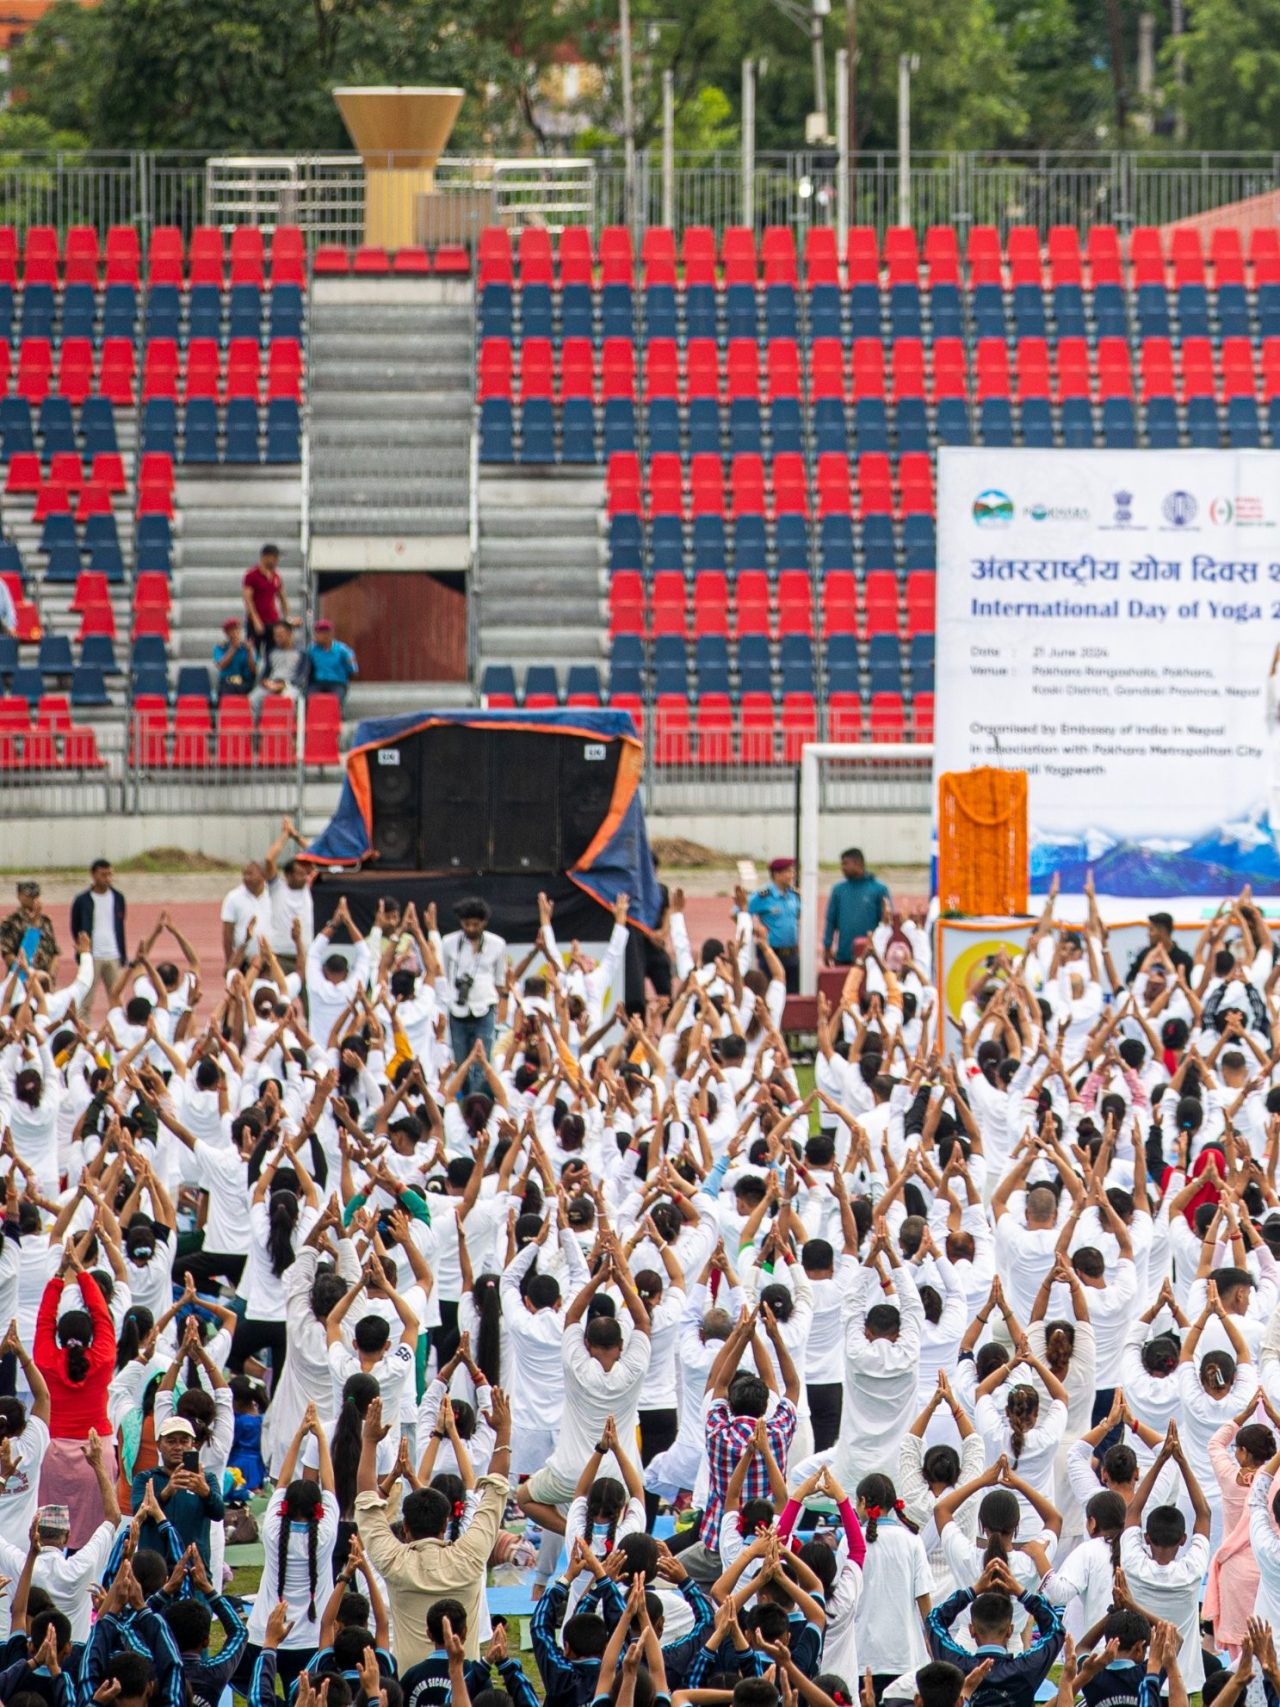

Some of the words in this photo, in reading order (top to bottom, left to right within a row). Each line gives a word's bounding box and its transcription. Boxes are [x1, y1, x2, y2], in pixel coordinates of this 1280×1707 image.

[971, 554, 1120, 587] अंतरराष्ट्रीय
[1129, 554, 1182, 582] योग
[1191, 554, 1259, 583] दिवस
[971, 598, 1119, 620] International
[1128, 598, 1169, 623] Day
[1178, 599, 1200, 620] of
[1208, 600, 1262, 624] Yoga
[970, 646, 1000, 657] Date
[1049, 647, 1077, 658] June
[970, 665, 1009, 677] Venue
[1032, 665, 1082, 678] Pokhara
[1225, 686, 1260, 699] Nepal
[969, 721, 1037, 736] Organised
[1041, 722, 1056, 737] by
[1060, 723, 1116, 738] Embassy
[1120, 724, 1133, 735] of
[1137, 724, 1168, 736] India
[1173, 725, 1183, 735] in
[1187, 724, 1225, 738] Nepal
[985, 743, 1058, 755] association
[1062, 744, 1088, 755] with
[1092, 744, 1146, 757] Pokhara
[1236, 744, 1263, 759] City
[395, 1346, 412, 1362] 56
